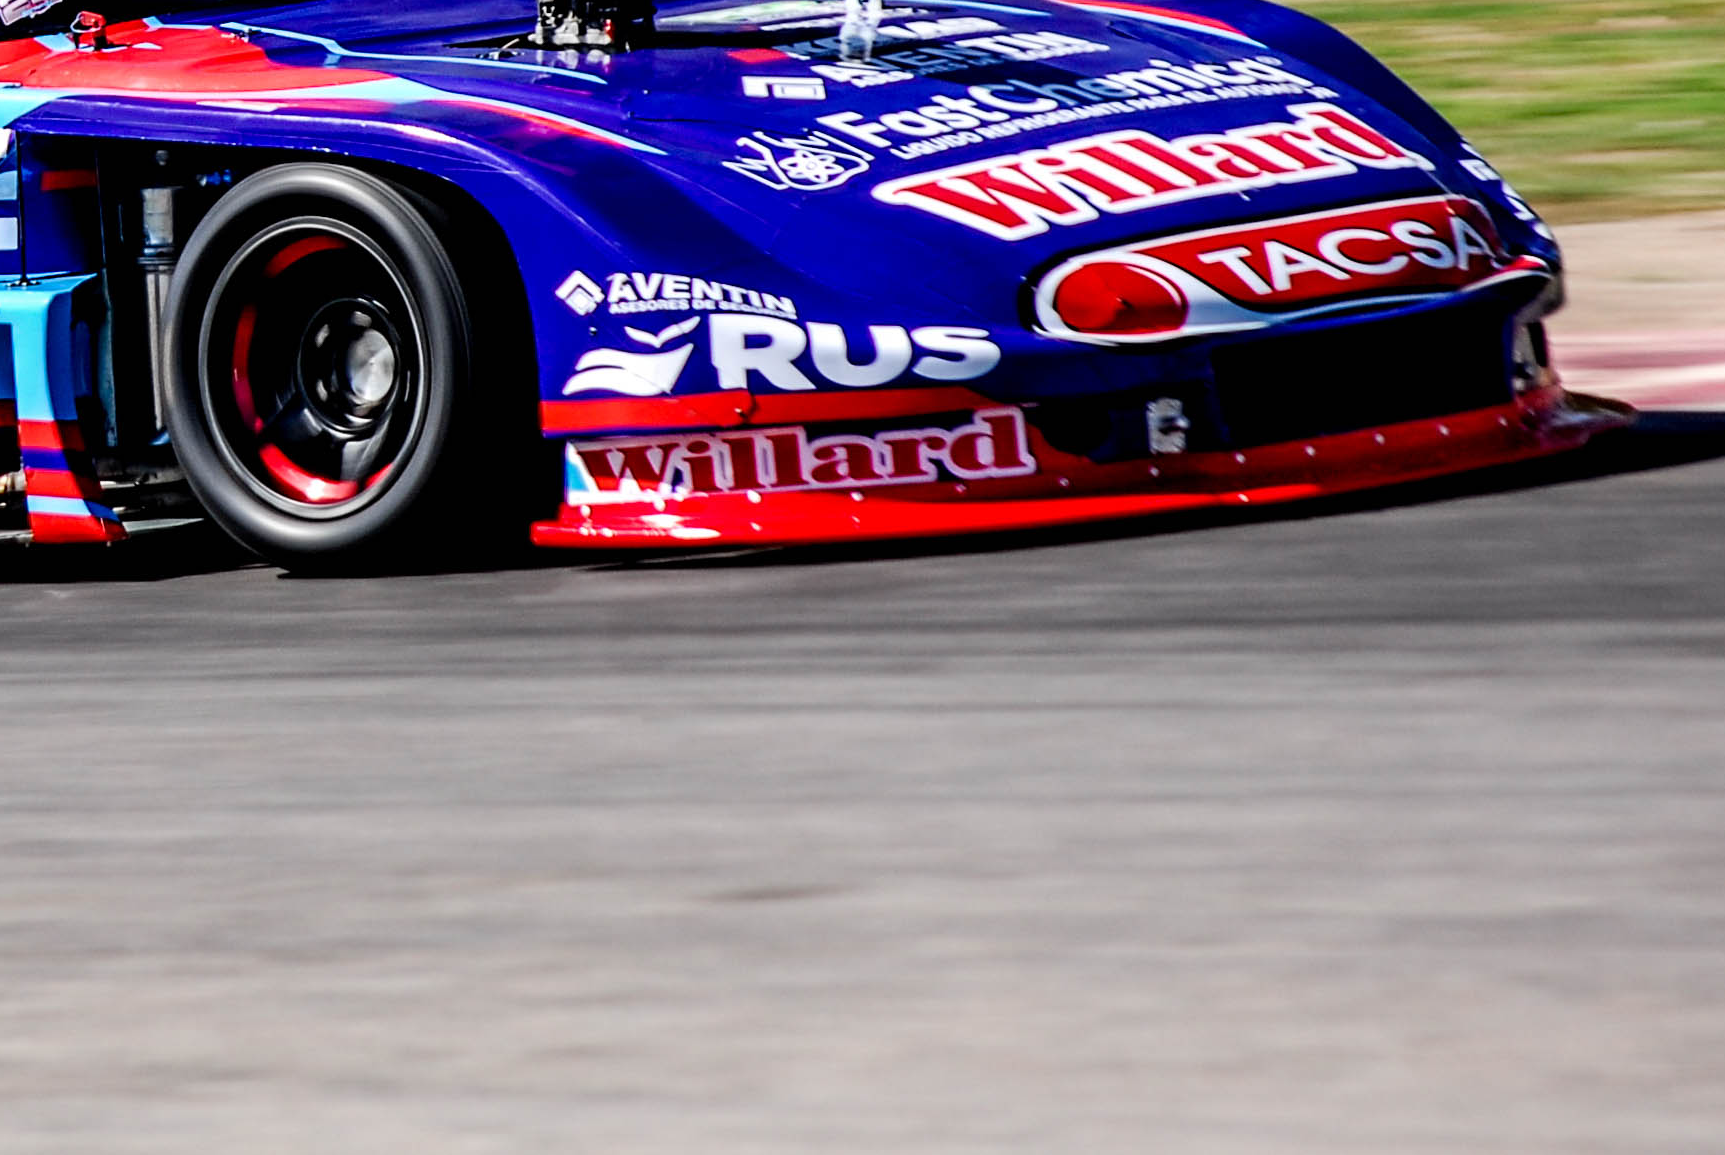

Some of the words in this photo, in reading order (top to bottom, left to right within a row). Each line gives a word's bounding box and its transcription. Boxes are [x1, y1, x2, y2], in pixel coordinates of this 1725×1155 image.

[890, 131, 984, 160] LIQUIDO
[894, 109, 1415, 229] Willard
[1197, 214, 1500, 295] TACSA
[607, 273, 797, 315] AVENTIN
[609, 299, 689, 314] ASESORES
[692, 299, 716, 310] DE
[709, 314, 1001, 391] RUS
[576, 414, 1034, 493] Willard
